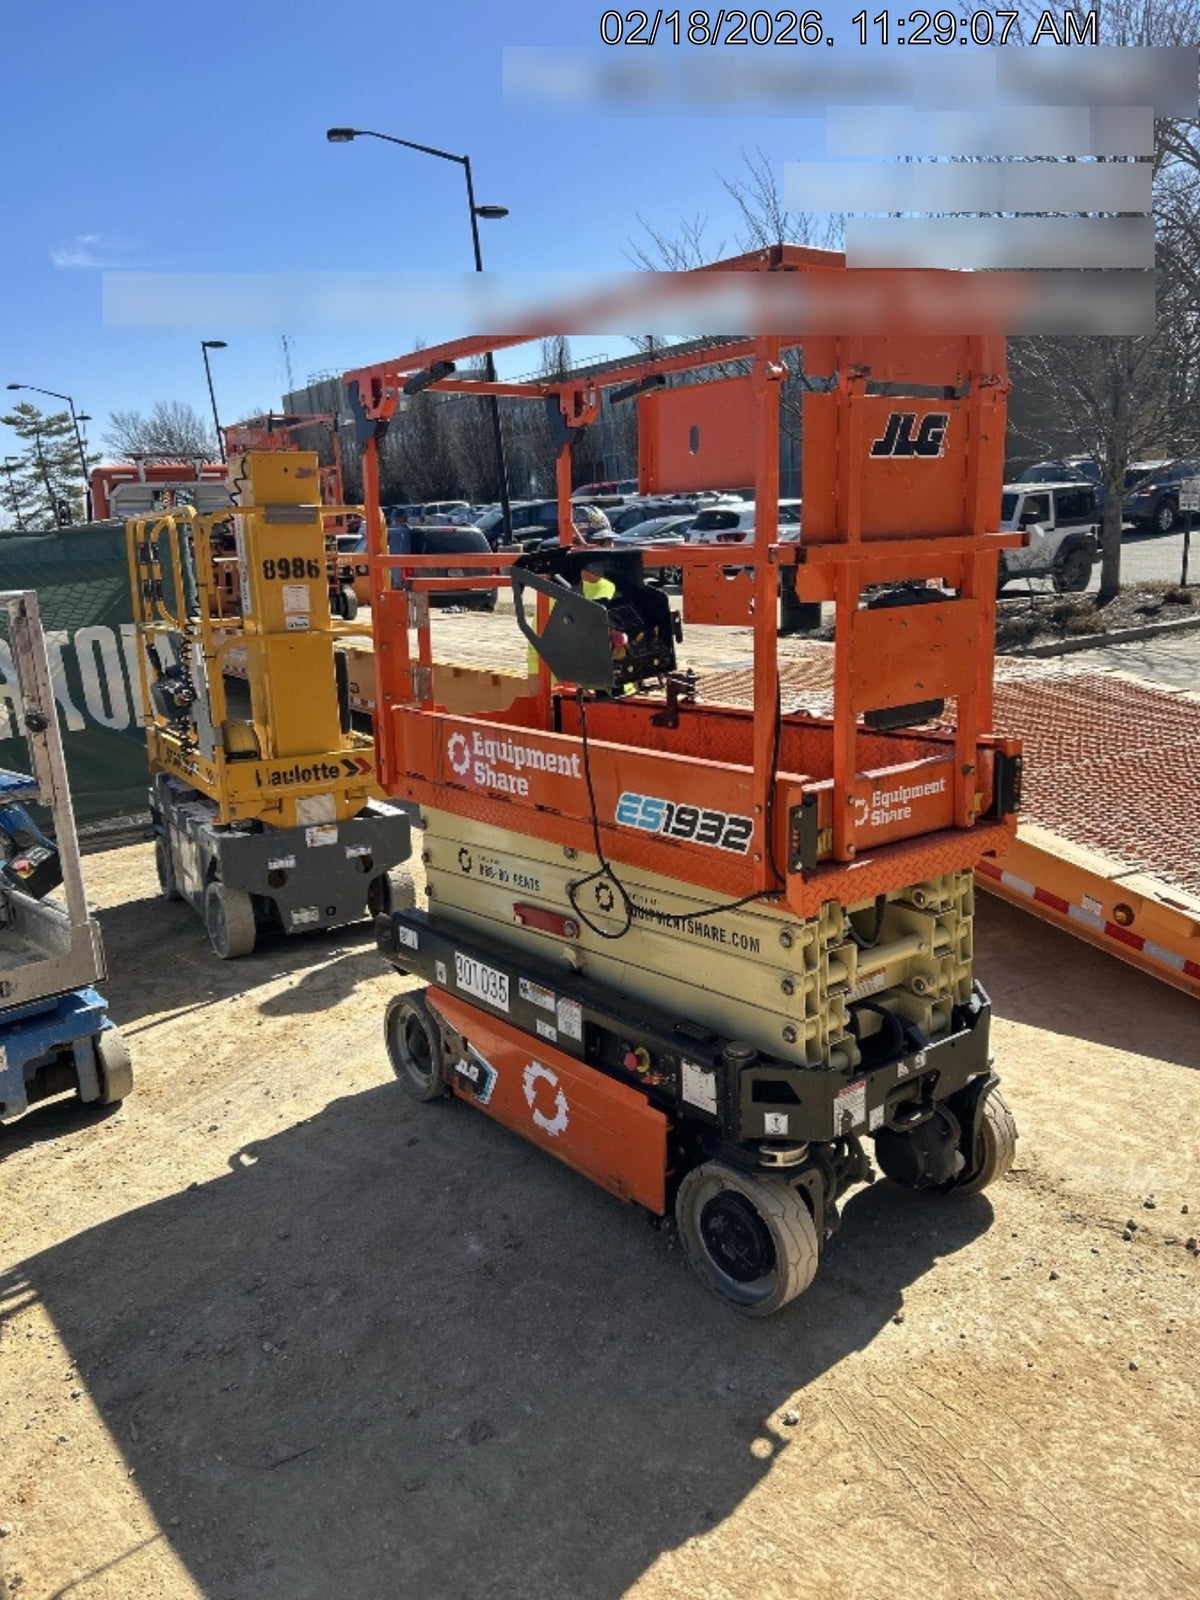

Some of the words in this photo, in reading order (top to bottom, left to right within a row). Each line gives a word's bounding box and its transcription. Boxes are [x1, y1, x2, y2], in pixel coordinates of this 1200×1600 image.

[868, 411, 950, 459] JLG
[263, 557, 321, 580] 8986
[472, 731, 582, 779] Equipment
[473, 760, 529, 796] Share
[872, 778, 947, 808] Equipment
[615, 792, 754, 854] ES1932
[870, 806, 912, 827] Share
